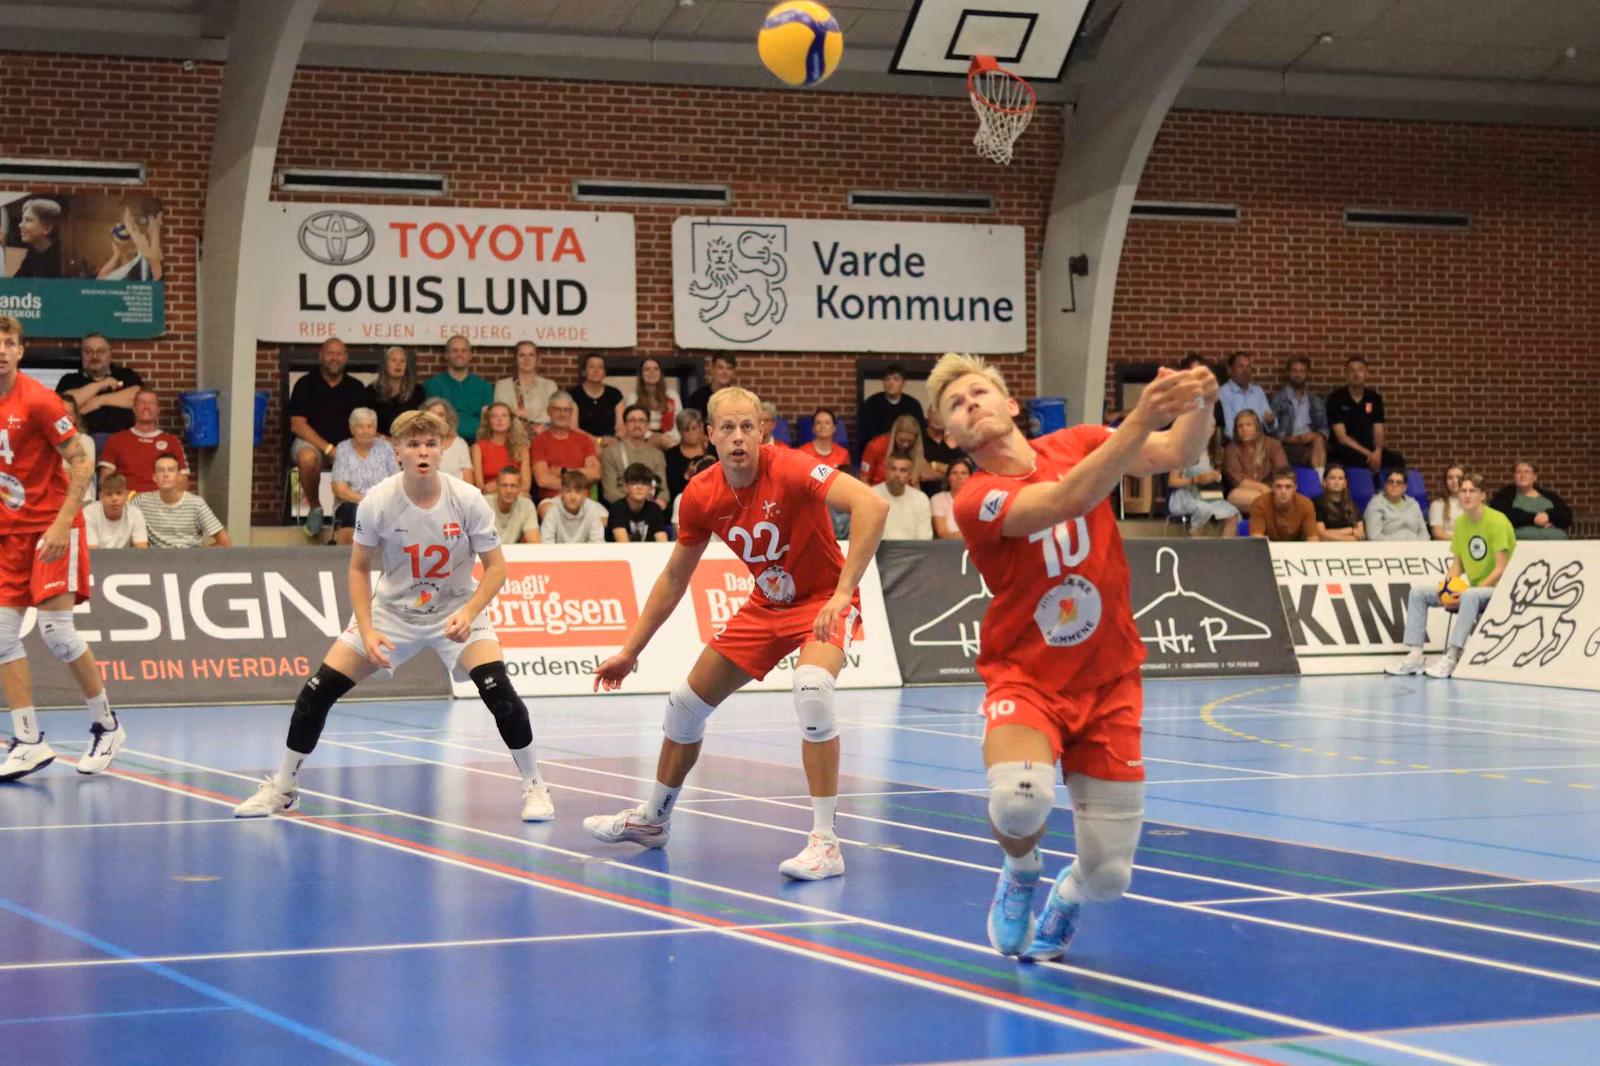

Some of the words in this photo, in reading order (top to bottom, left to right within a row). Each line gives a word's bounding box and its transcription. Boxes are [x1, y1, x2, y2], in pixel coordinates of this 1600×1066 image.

[389, 222, 586, 263] TOYOTA
[812, 241, 926, 278] Varde
[299, 273, 443, 314] LOUIS
[458, 277, 588, 316] LUND
[816, 285, 1013, 323] Kommune
[300, 322, 337, 337] RIBE
[362, 323, 415, 338] VEJEN
[440, 325, 512, 340] ESBJERG
[535, 326, 589, 341] VARDE
[403, 543, 451, 579] 12
[728, 521, 790, 563] 22
[1028, 515, 1091, 578] 10
[18, 571, 341, 642] ESIGN
[488, 591, 627, 635] Brugsen
[1155, 617, 1195, 654] Hr.
[96, 659, 135, 681] TIL
[141, 659, 184, 681] DIN
[192, 656, 310, 679] HVERDAG
[987, 700, 1016, 720] 10
